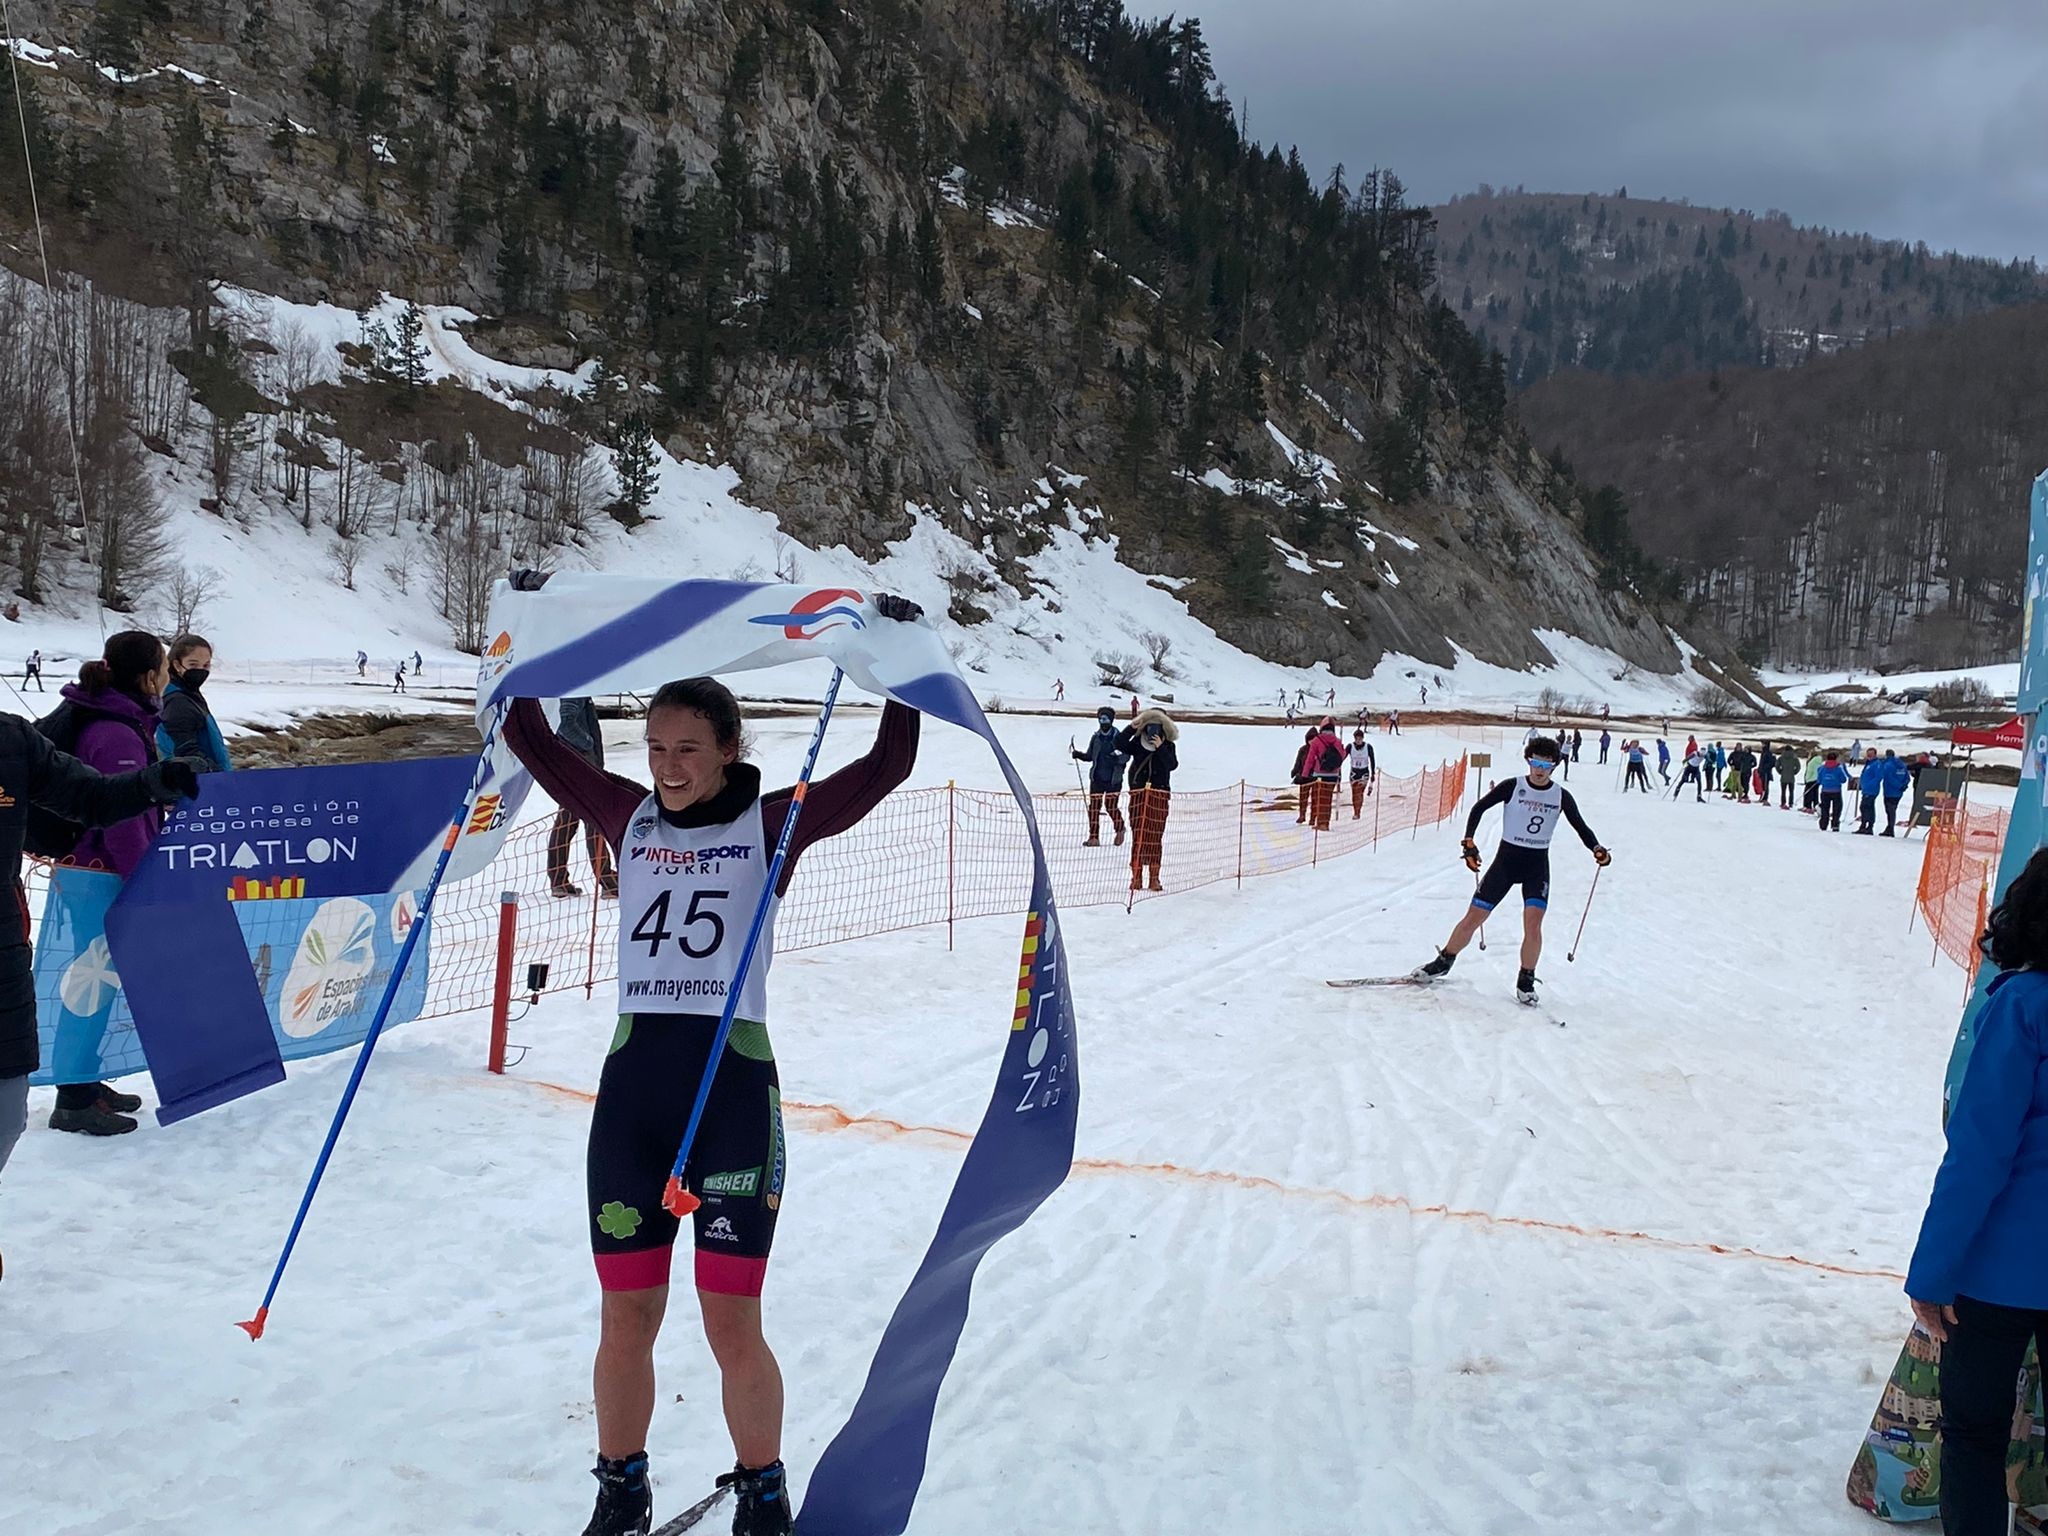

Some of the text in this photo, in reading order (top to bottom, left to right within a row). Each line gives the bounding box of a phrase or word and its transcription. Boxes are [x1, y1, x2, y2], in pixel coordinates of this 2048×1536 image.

[175, 800, 359, 819] ederación
[161, 813, 359, 834] aragonesa de
[1527, 815, 1544, 834] 8
[158, 836, 357, 870] TRIATLON
[645, 845, 751, 864] INTERSPORT
[630, 889, 730, 959] 45
[316, 1003, 331, 1022] de
[703, 1172, 756, 1192] FINISHER
